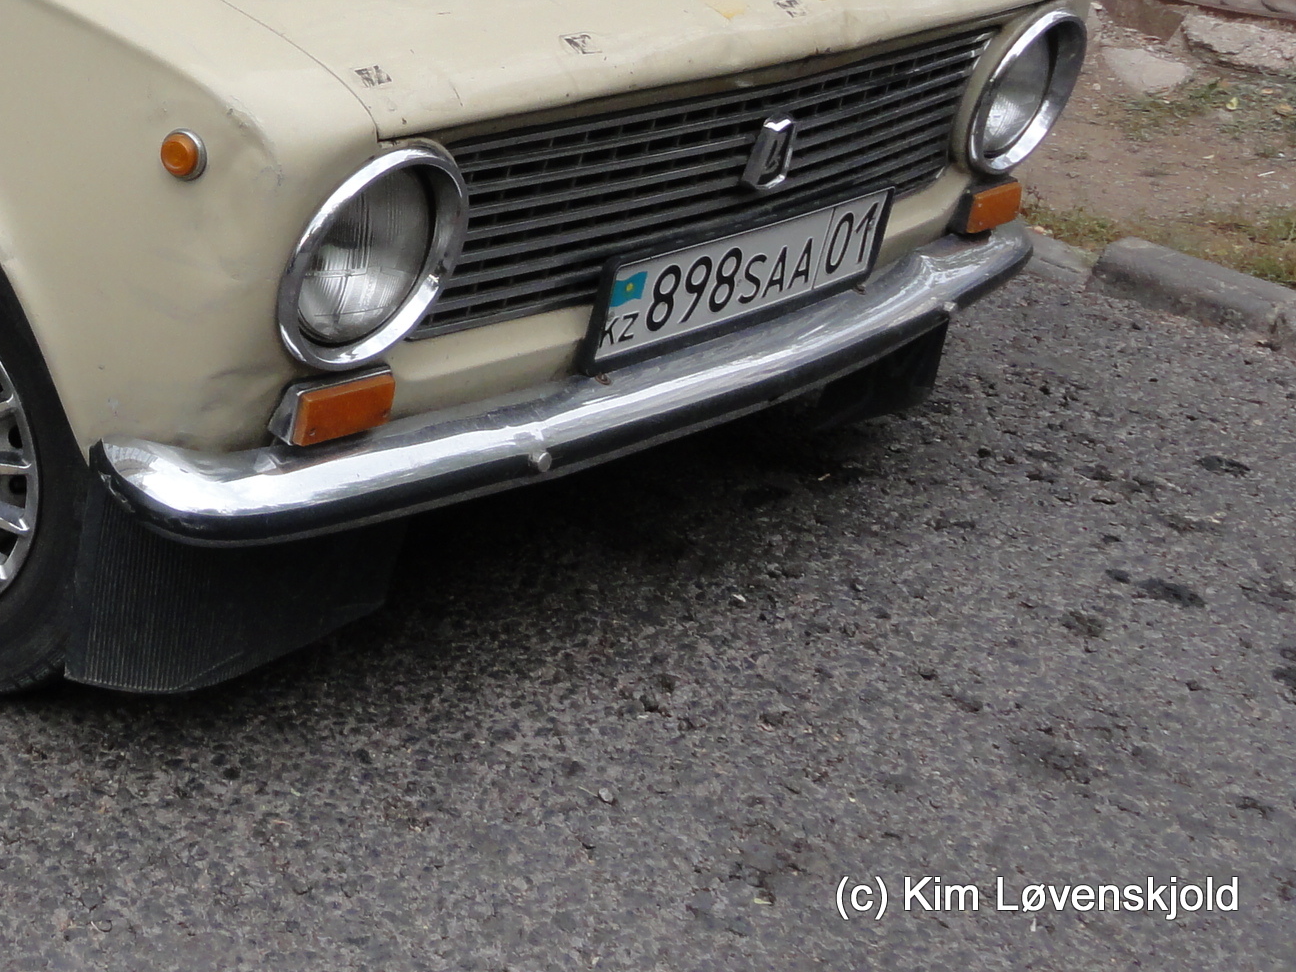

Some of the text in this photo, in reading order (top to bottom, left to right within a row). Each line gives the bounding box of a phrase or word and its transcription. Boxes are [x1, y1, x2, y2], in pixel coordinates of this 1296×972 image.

[599, 201, 880, 348] KZ 898SAA 01
